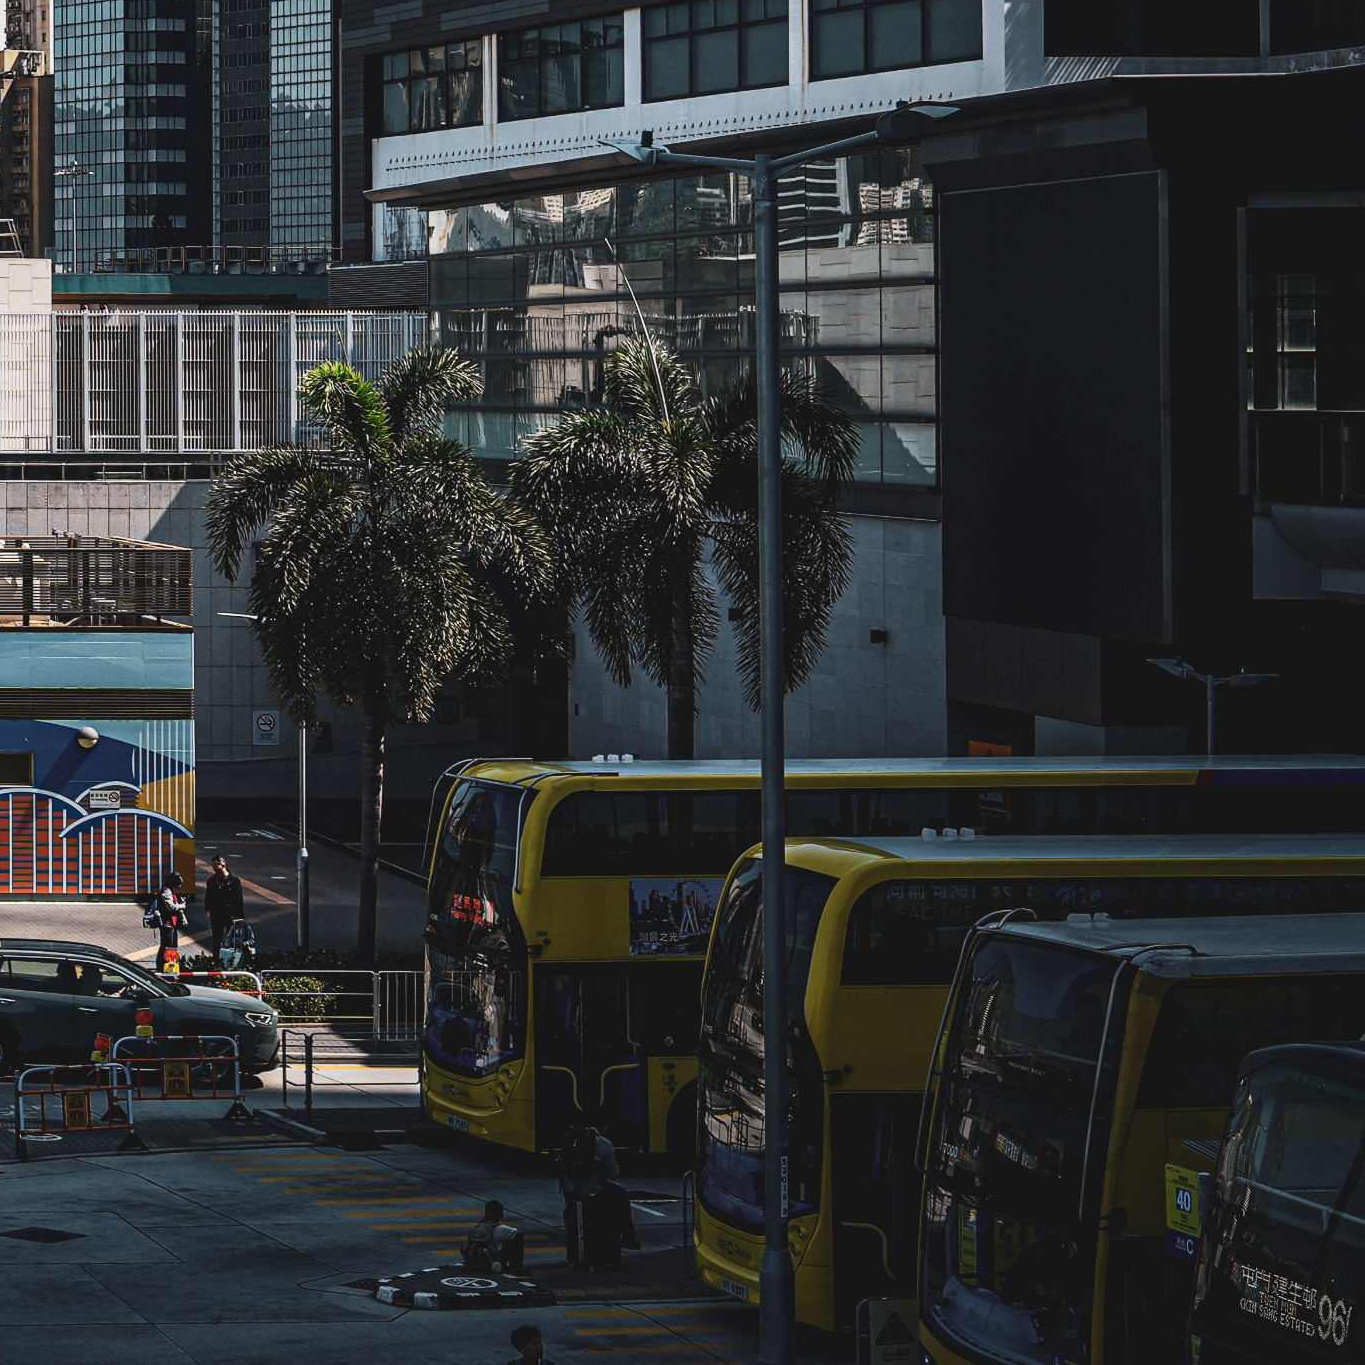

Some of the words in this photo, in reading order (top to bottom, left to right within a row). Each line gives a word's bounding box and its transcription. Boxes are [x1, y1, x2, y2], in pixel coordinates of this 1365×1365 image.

[1177, 1189, 1191, 1212] 40
[1241, 1265, 1318, 1310] 屯門建生邨
[1259, 1292, 1279, 1309] TUEN
[1281, 1300, 1297, 1317] MUN
